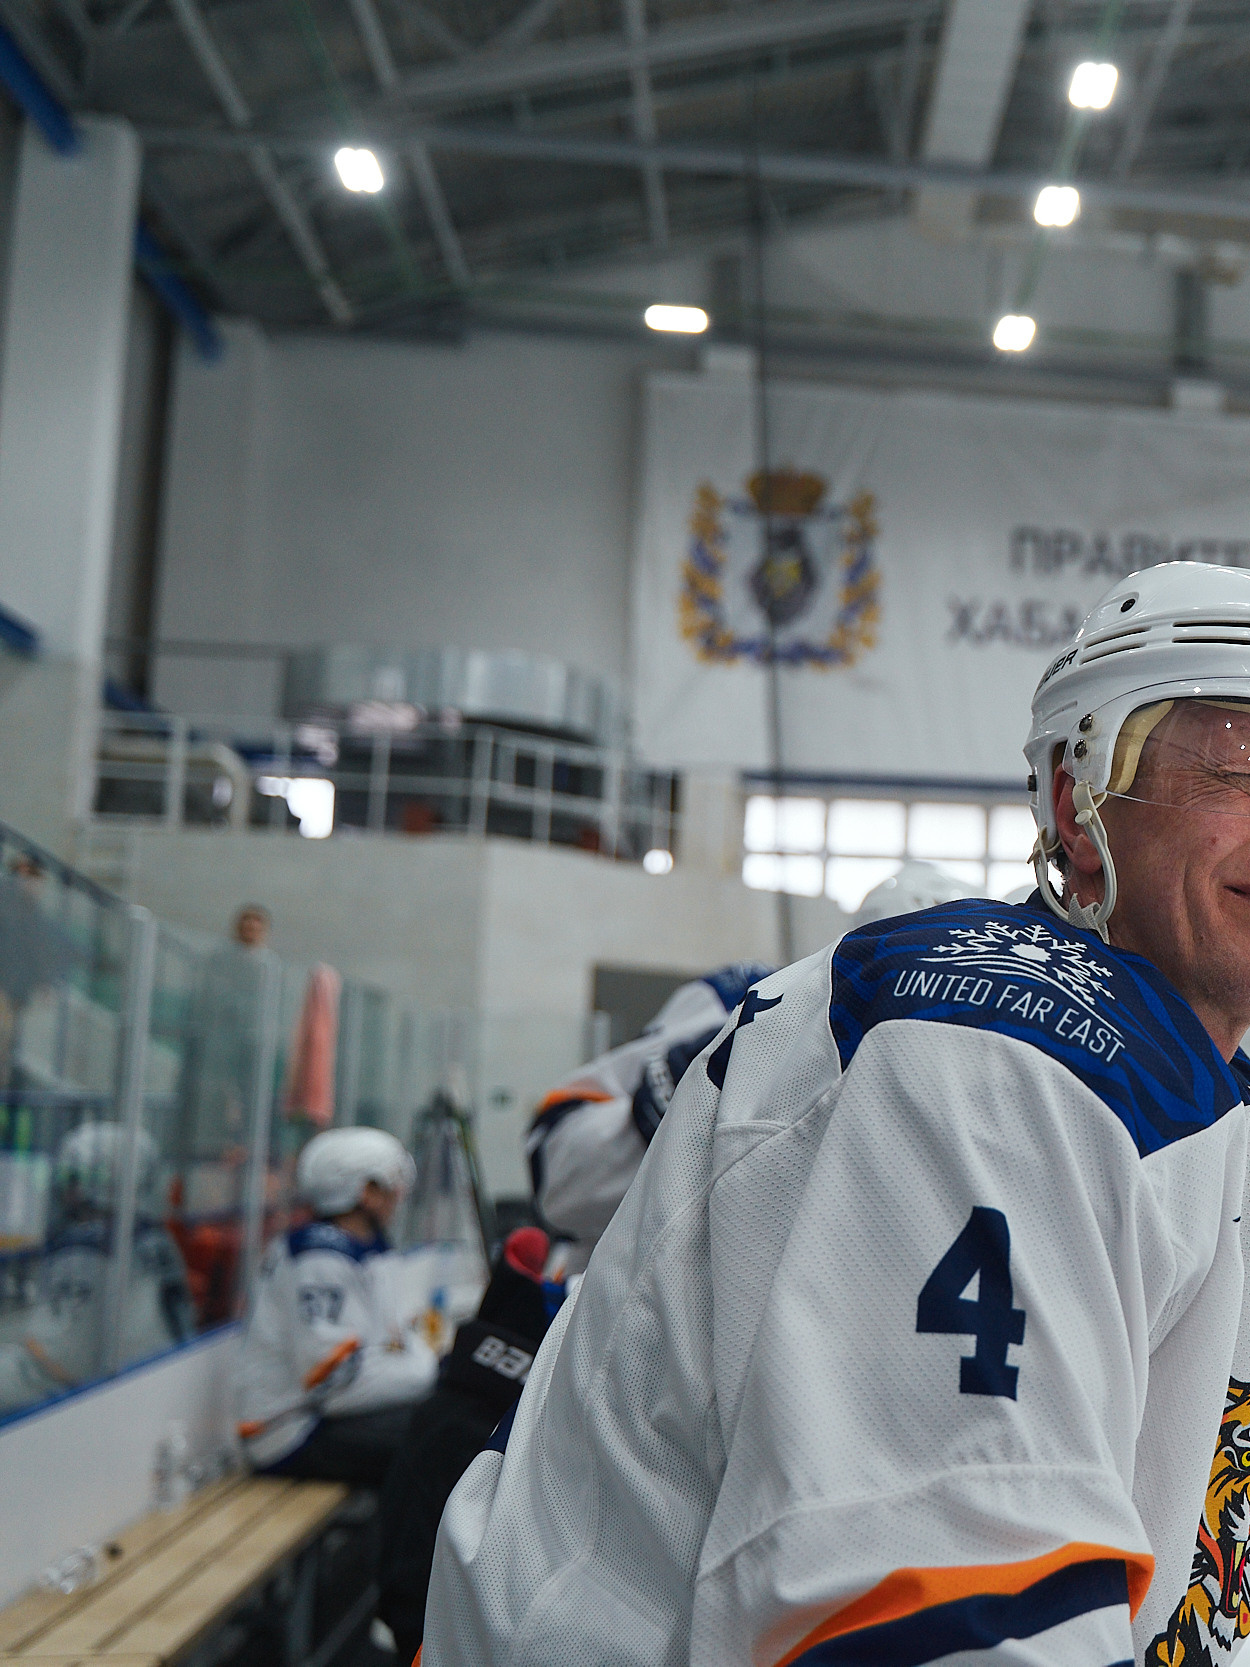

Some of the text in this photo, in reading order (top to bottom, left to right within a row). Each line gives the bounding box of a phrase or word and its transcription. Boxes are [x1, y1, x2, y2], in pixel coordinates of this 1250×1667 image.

[894, 970, 1125, 1062] UNITED FAR EAST
[916, 1205, 1027, 1402] 4
